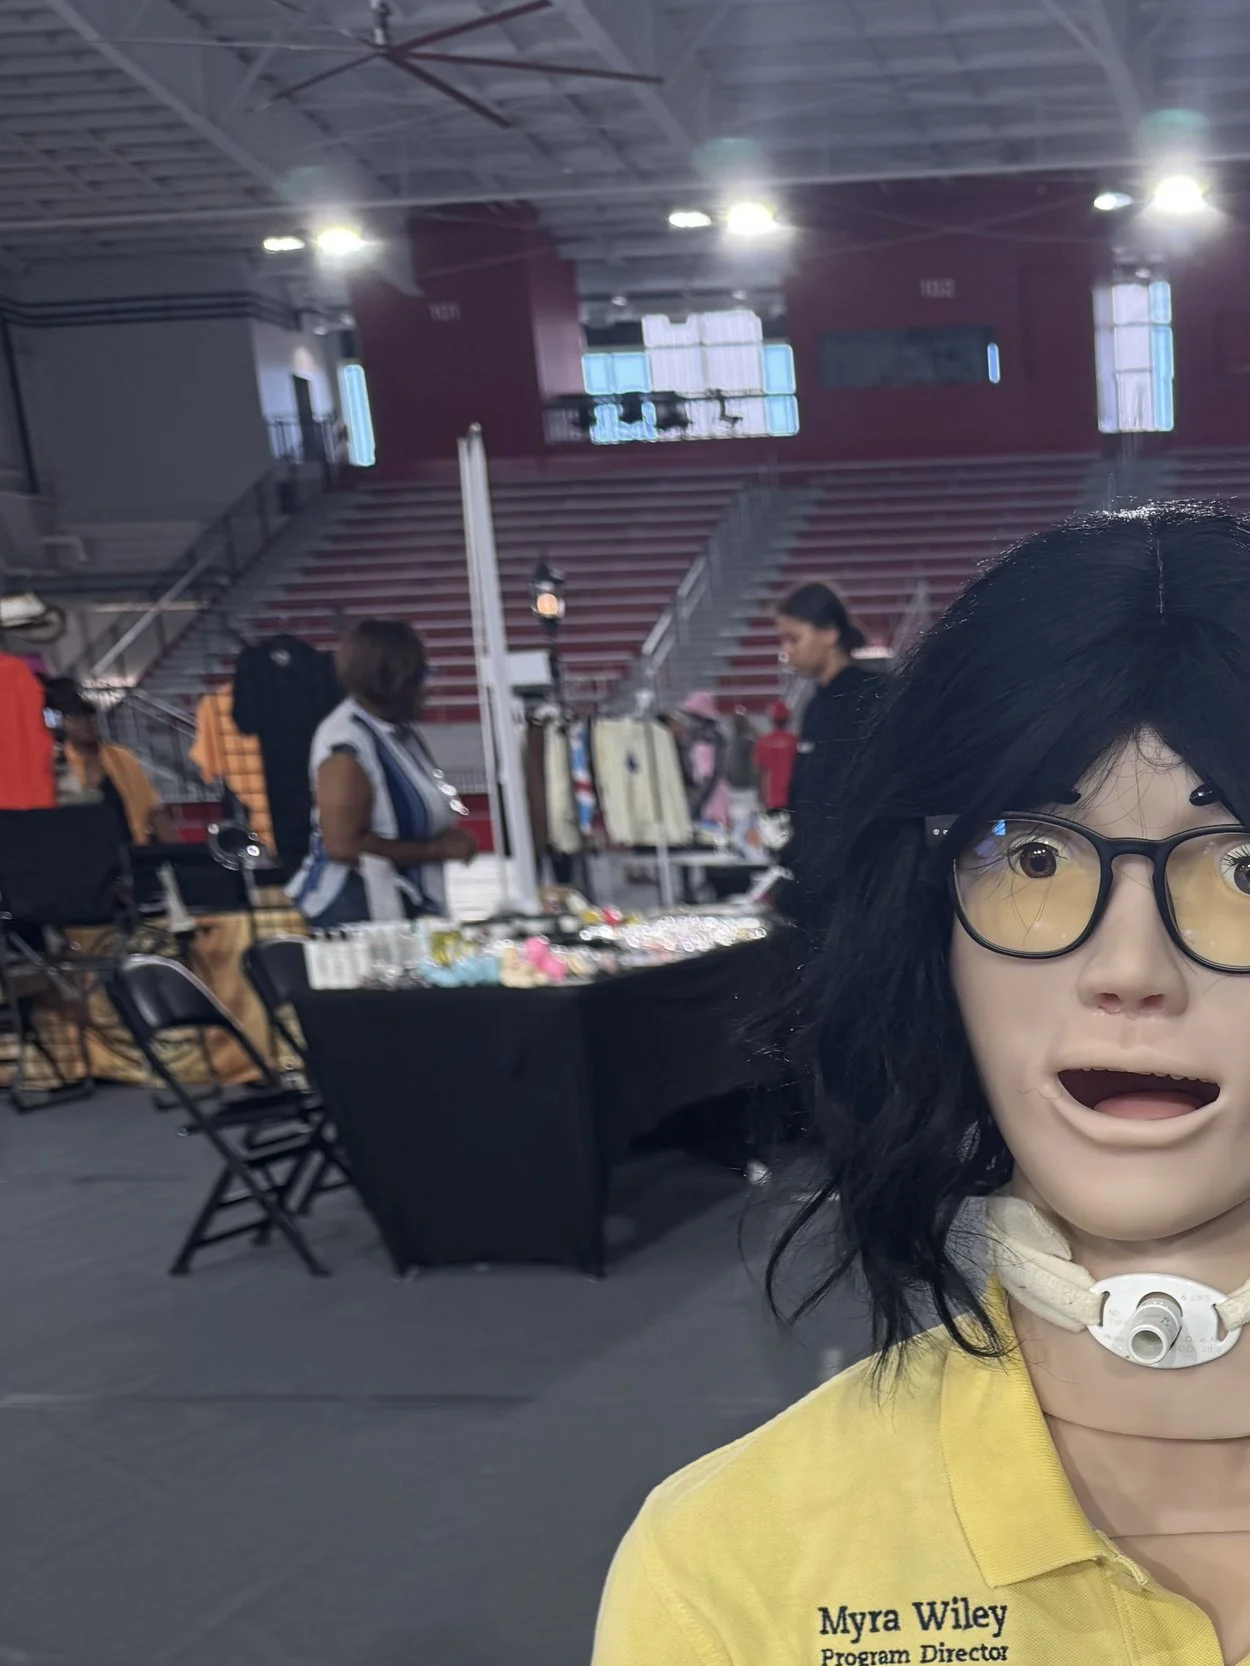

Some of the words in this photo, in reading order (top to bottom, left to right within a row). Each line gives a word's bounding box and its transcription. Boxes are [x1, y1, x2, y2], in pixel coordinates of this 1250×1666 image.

[817, 1605, 901, 1645] Myra
[912, 1596, 1008, 1639] Wiley
[920, 1642, 1009, 1664] Director
